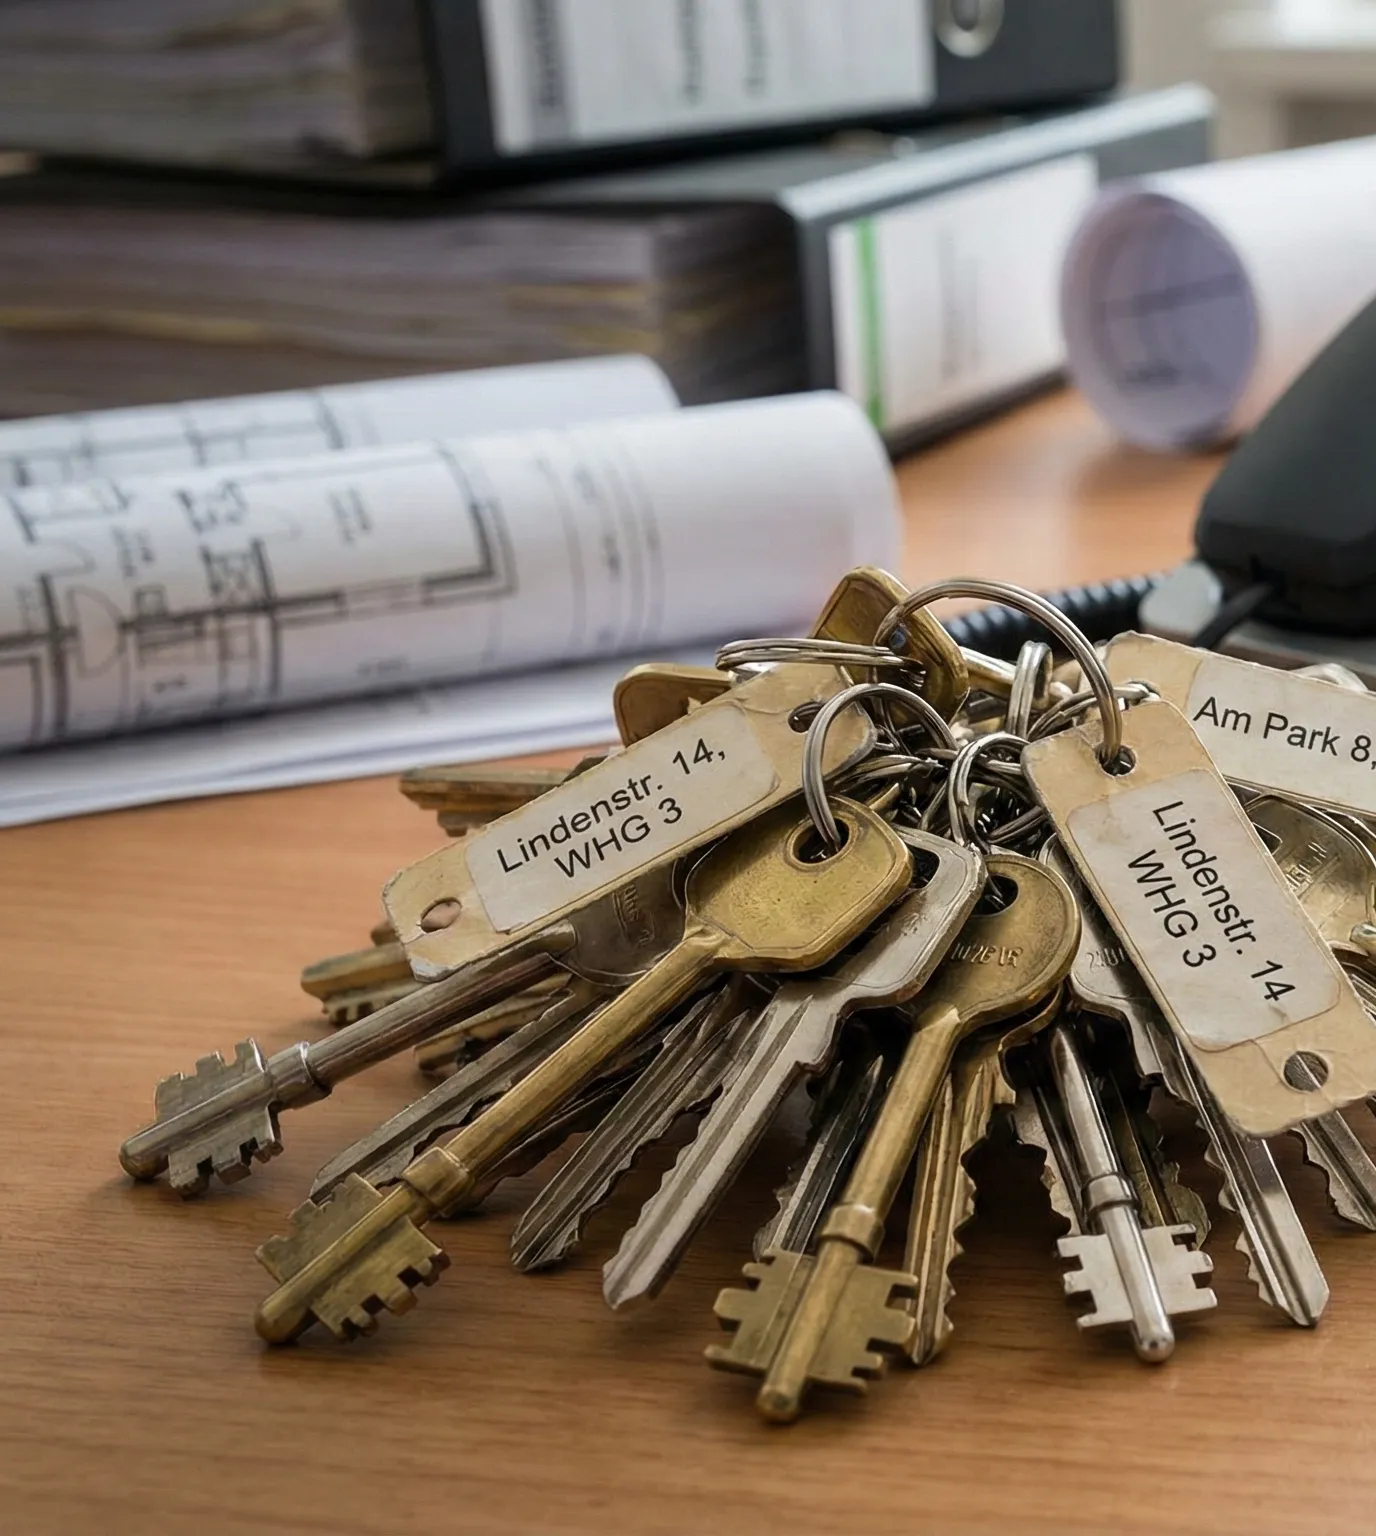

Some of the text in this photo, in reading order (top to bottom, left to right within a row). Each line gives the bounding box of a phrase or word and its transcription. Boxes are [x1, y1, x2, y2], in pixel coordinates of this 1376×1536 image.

[1193, 696, 1252, 735] Am
[1263, 711, 1341, 757] Park
[1350, 734, 1376, 771] 8,
[496, 738, 727, 874] Lindenstr. 14,
[554, 797, 684, 879] WHG 3
[1127, 848, 1217, 968] WHG 3
[1153, 801, 1296, 1002] Lindenstr. 14
